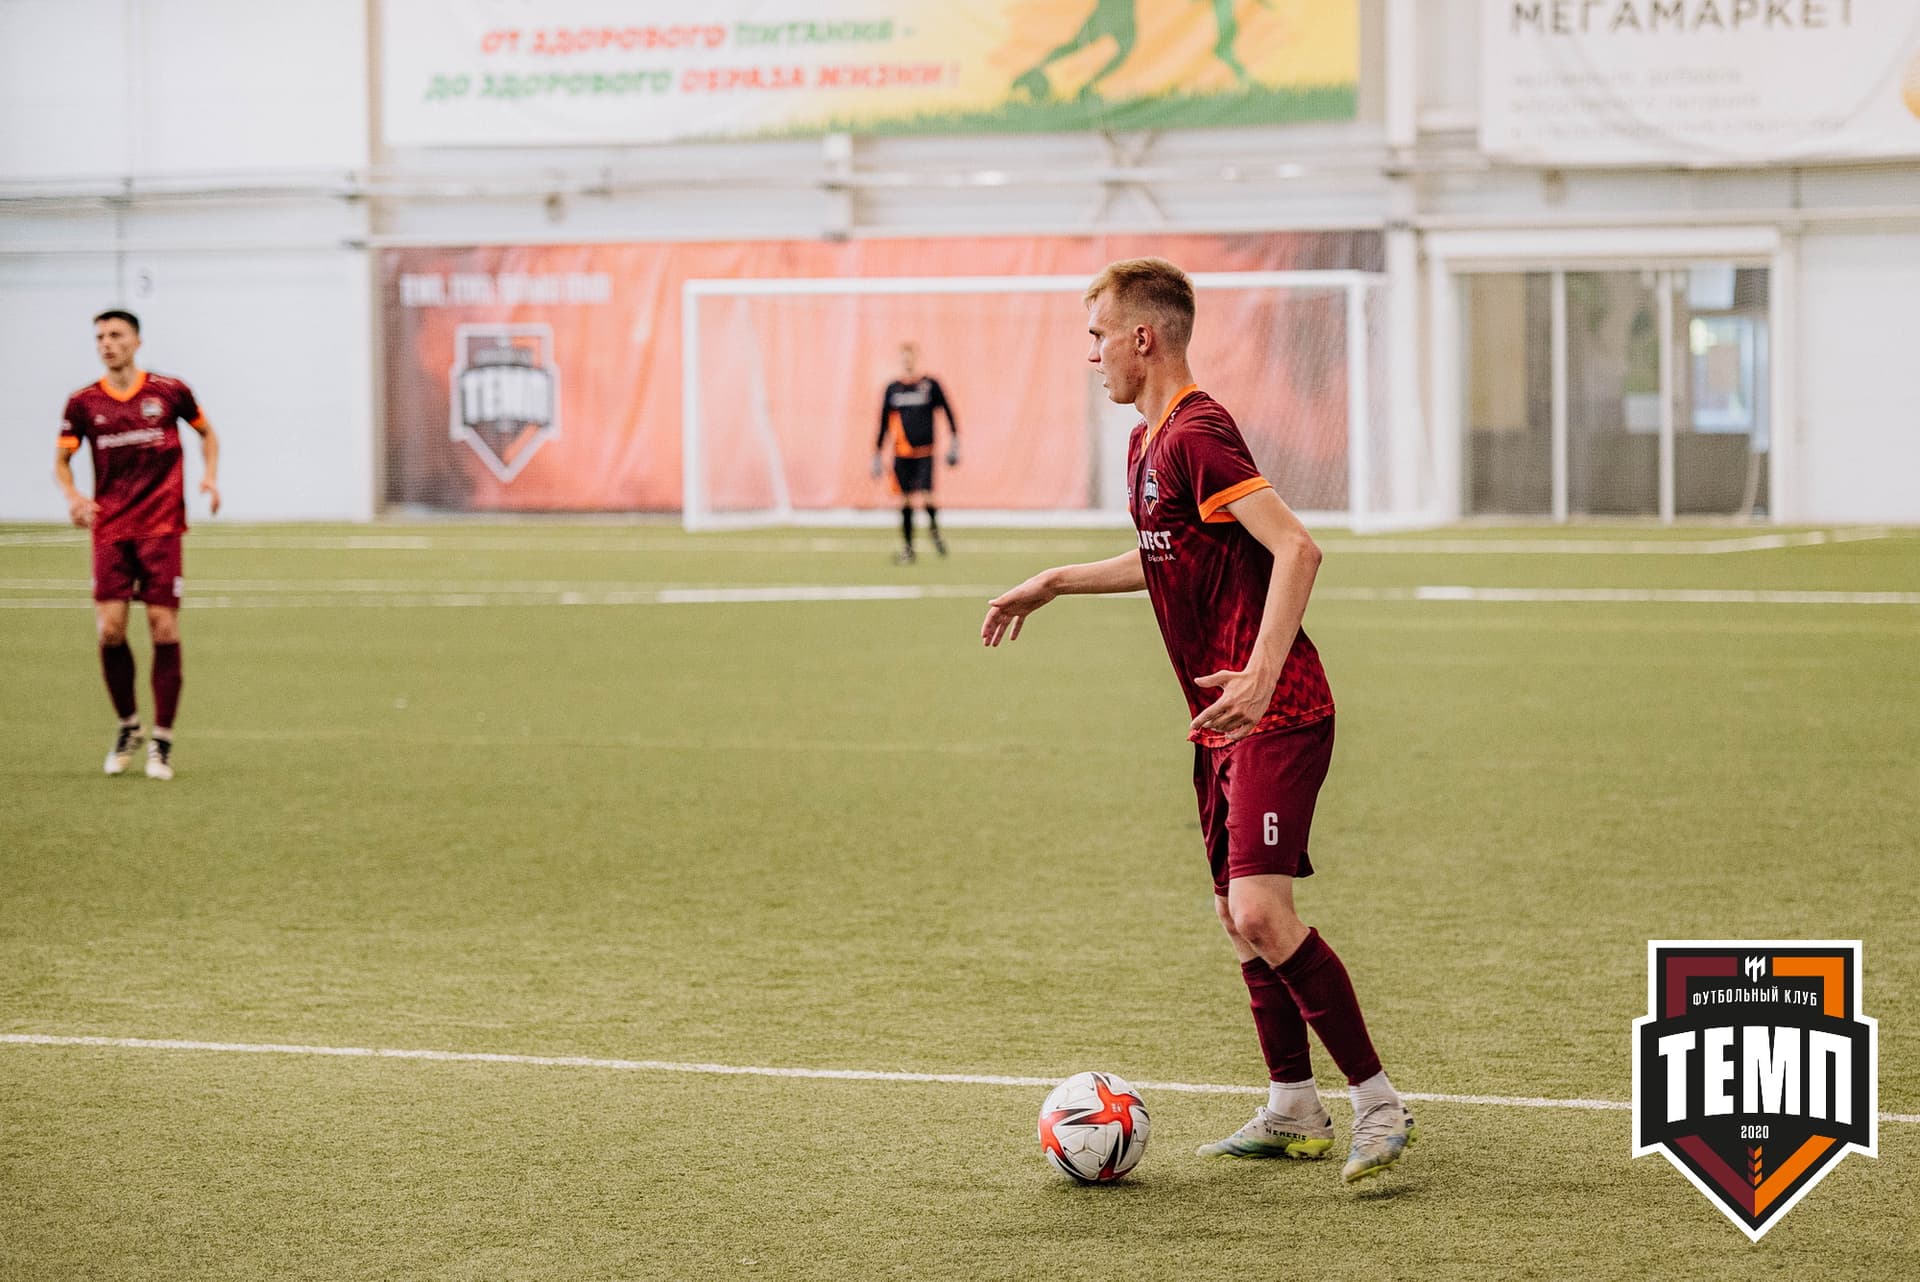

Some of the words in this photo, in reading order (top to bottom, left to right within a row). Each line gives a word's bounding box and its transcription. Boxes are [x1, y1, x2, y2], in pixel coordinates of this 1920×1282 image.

[480, 29, 519, 53] ОТ
[530, 25, 726, 54] ЗДОРОВОГО
[424, 72, 471, 101] ДО
[480, 70, 673, 98] ЗДОРОВОГО
[681, 66, 805, 93] ОБРАЗА
[1263, 811, 1279, 846] 6
[1265, 1127, 1307, 1142] NEMESIS
